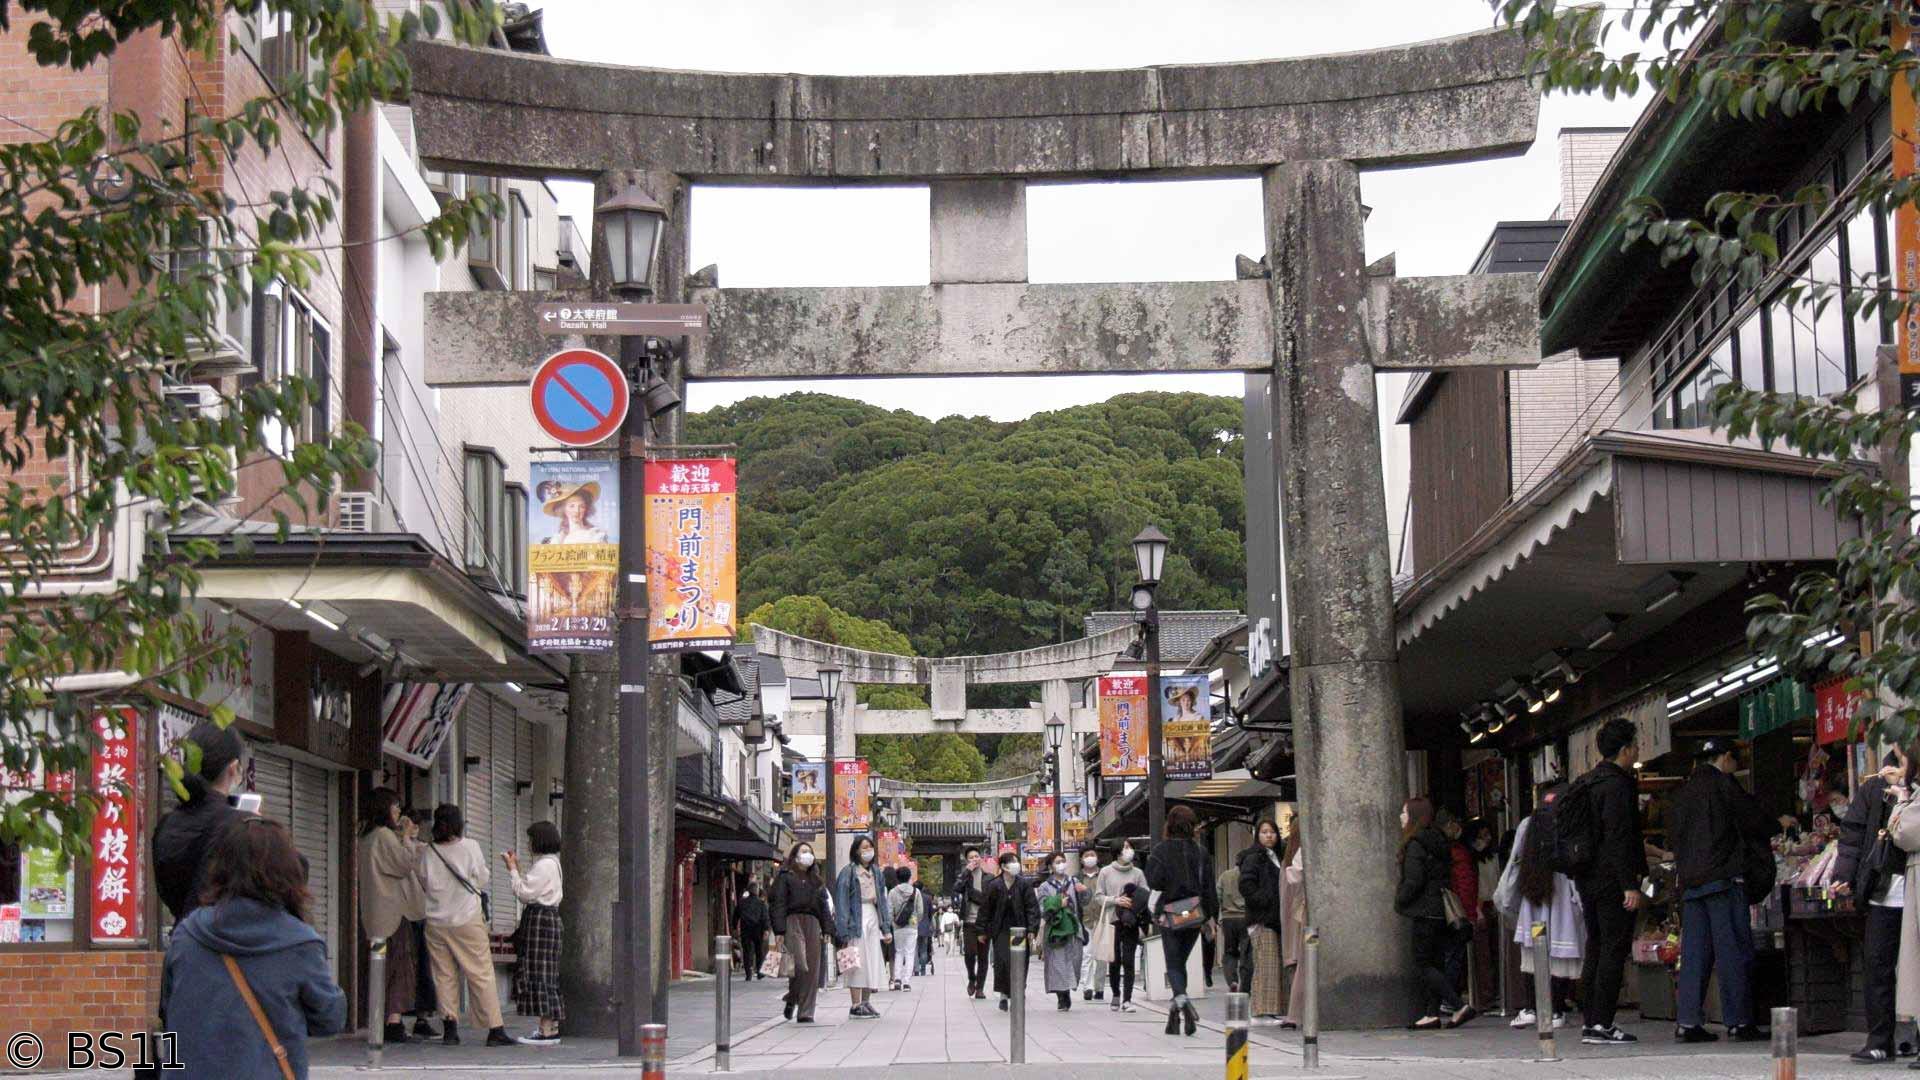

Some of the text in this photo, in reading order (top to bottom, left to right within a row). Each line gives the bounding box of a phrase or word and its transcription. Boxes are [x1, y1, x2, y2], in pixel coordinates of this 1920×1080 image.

[560, 321, 607, 329] Dazaifu Hall
[671, 463, 710, 484] 歓迎
[659, 482, 721, 494] 太宰府天満宮
[678, 507, 703, 632] 門前まつり
[1111, 679, 1134, 690] 歓迎
